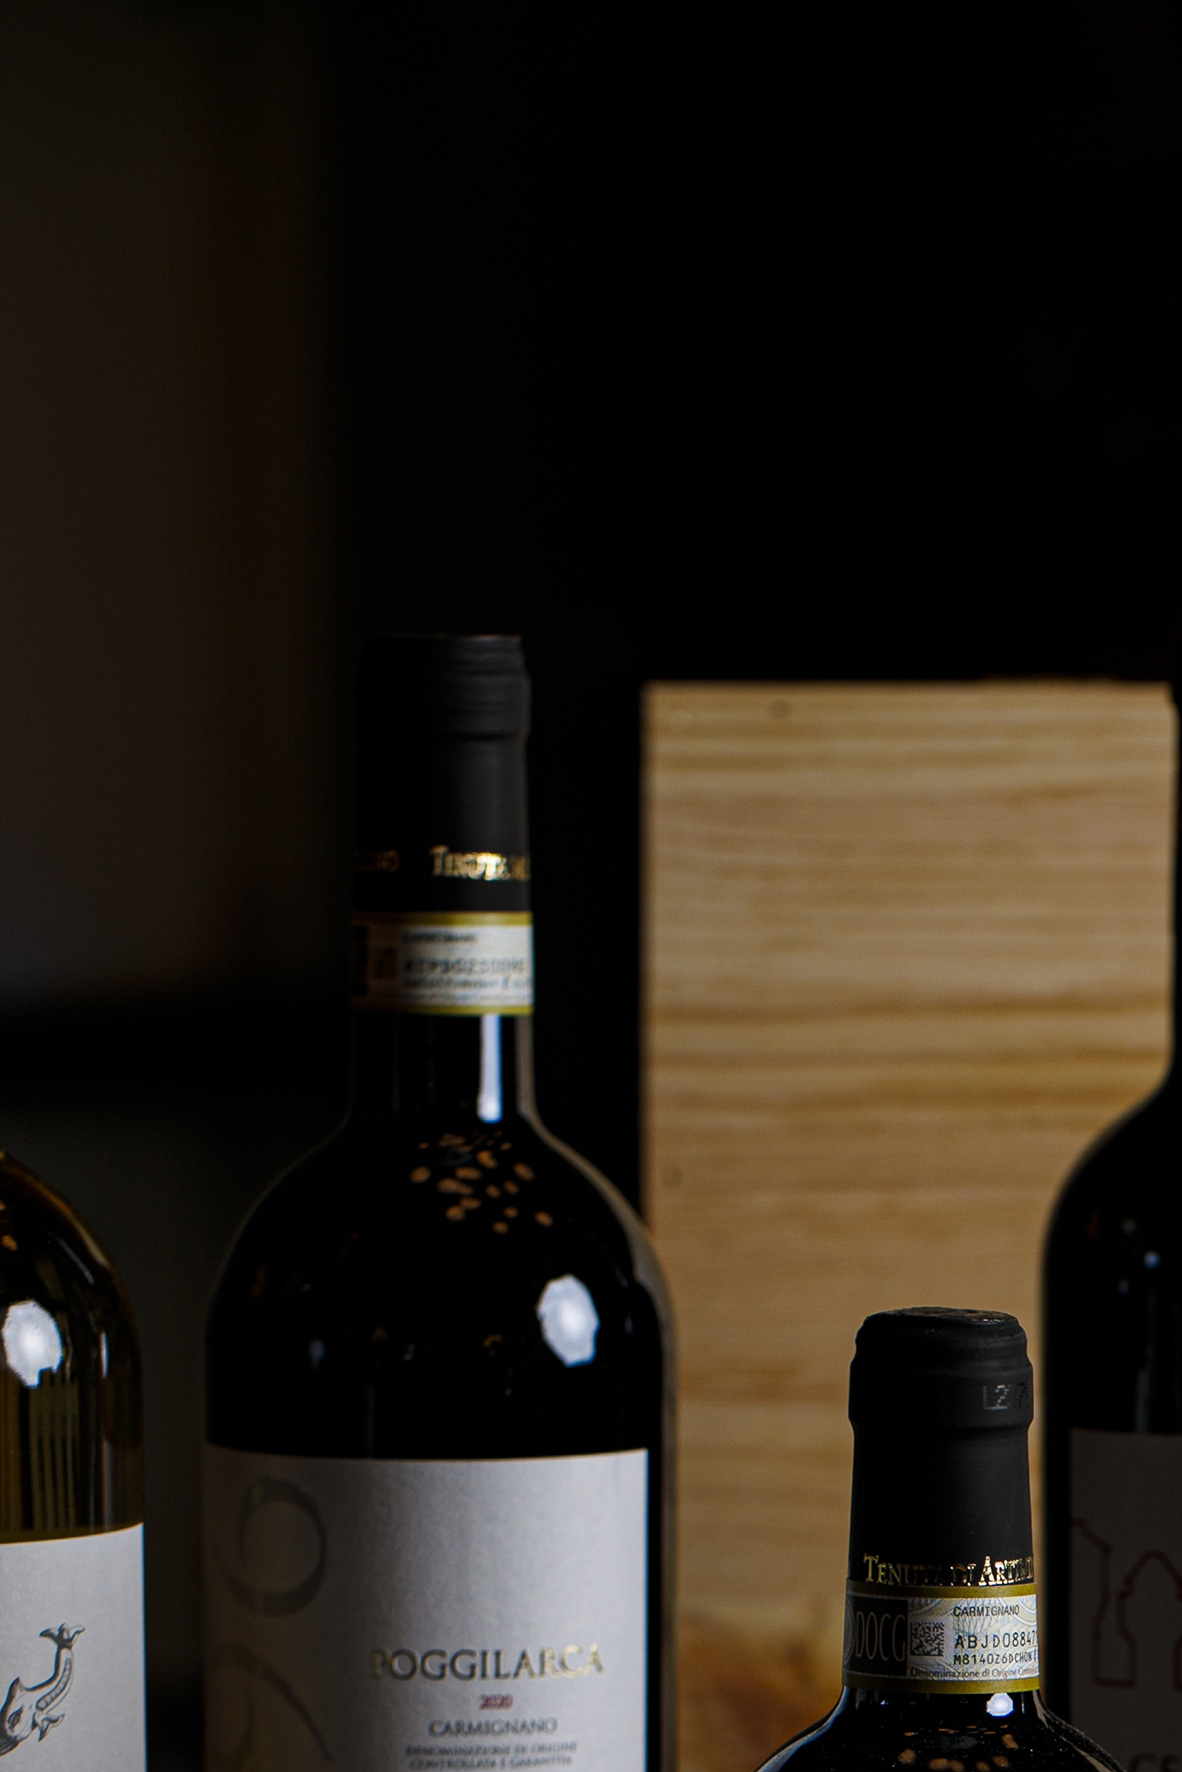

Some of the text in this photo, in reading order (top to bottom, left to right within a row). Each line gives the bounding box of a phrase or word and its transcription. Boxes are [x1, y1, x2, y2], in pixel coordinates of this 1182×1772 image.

[953, 1604, 1020, 1617] CARMIGNANO
[856, 1611, 906, 1662] DOCG
[371, 1643, 606, 1681] POGGILARCA
